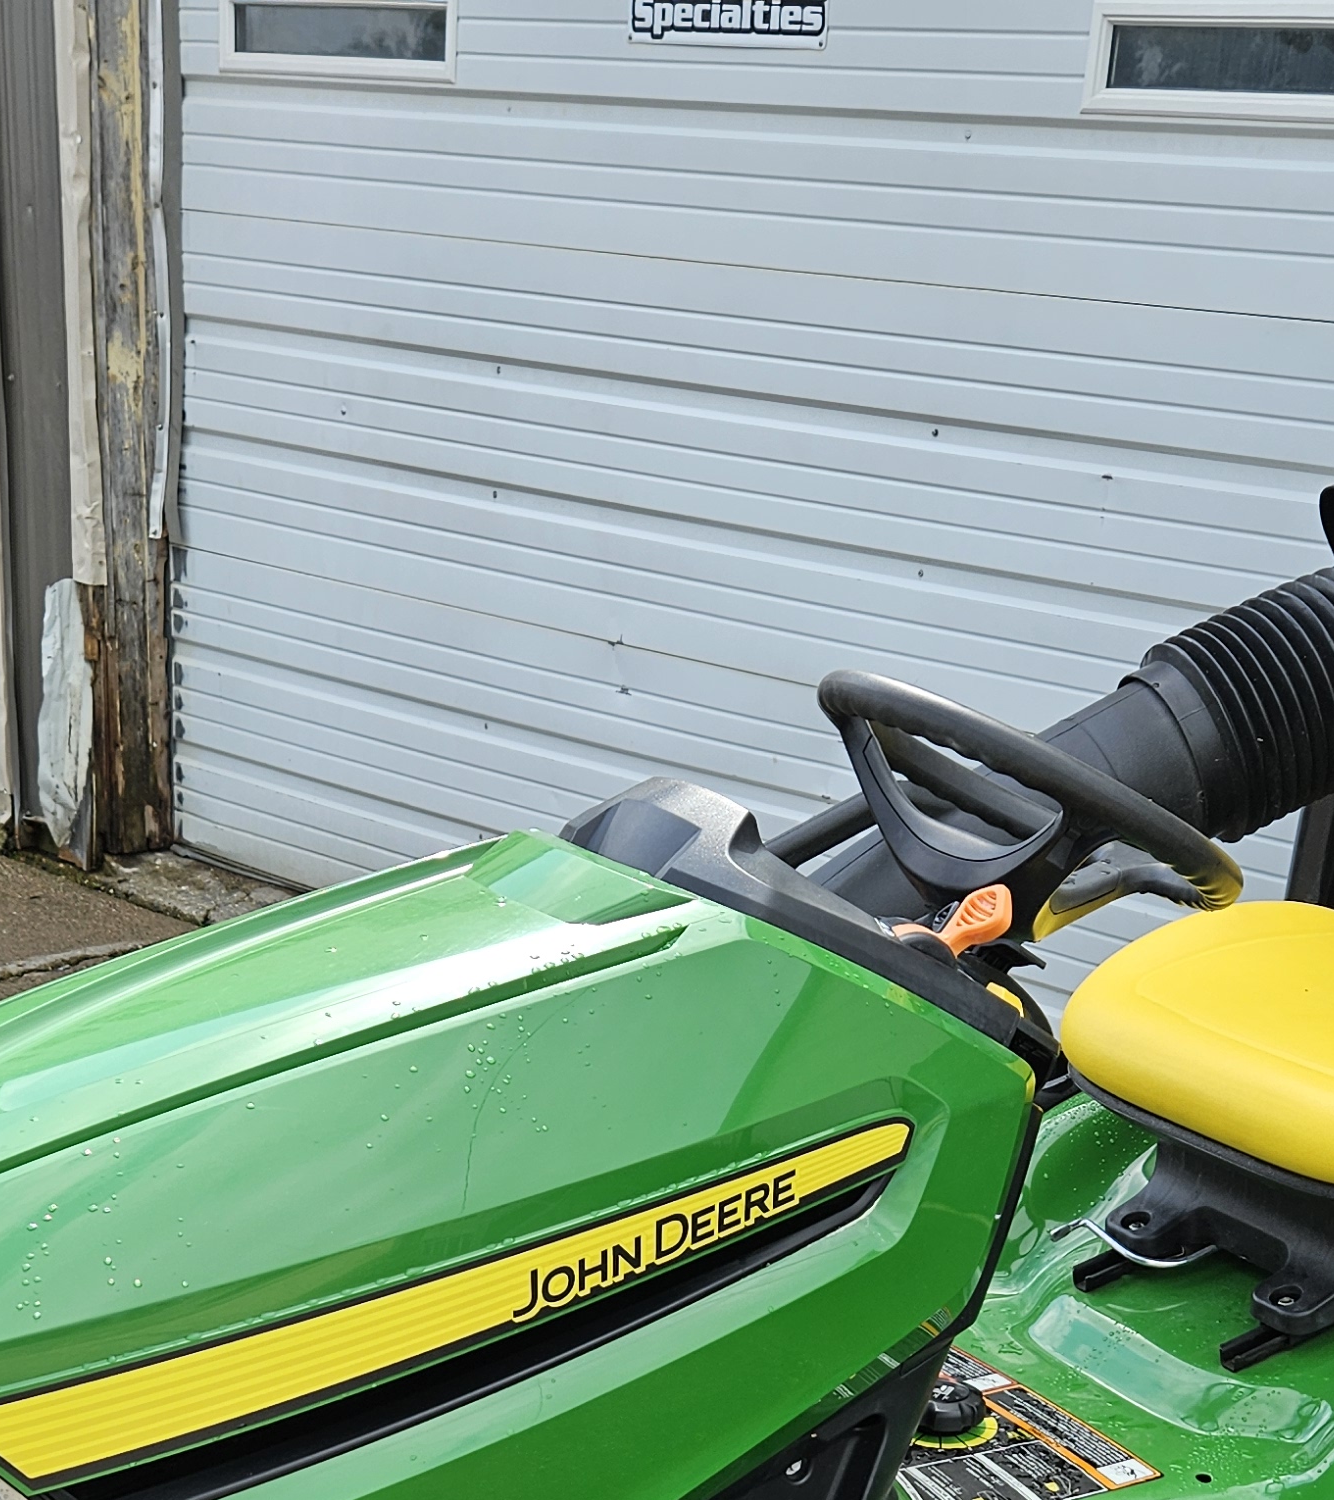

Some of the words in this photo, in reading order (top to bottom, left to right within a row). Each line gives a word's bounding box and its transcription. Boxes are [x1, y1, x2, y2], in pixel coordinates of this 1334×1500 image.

[633, 0, 824, 38] Specialties
[513, 1236, 641, 1319] JOHN
[655, 1169, 798, 1259] DEERE
